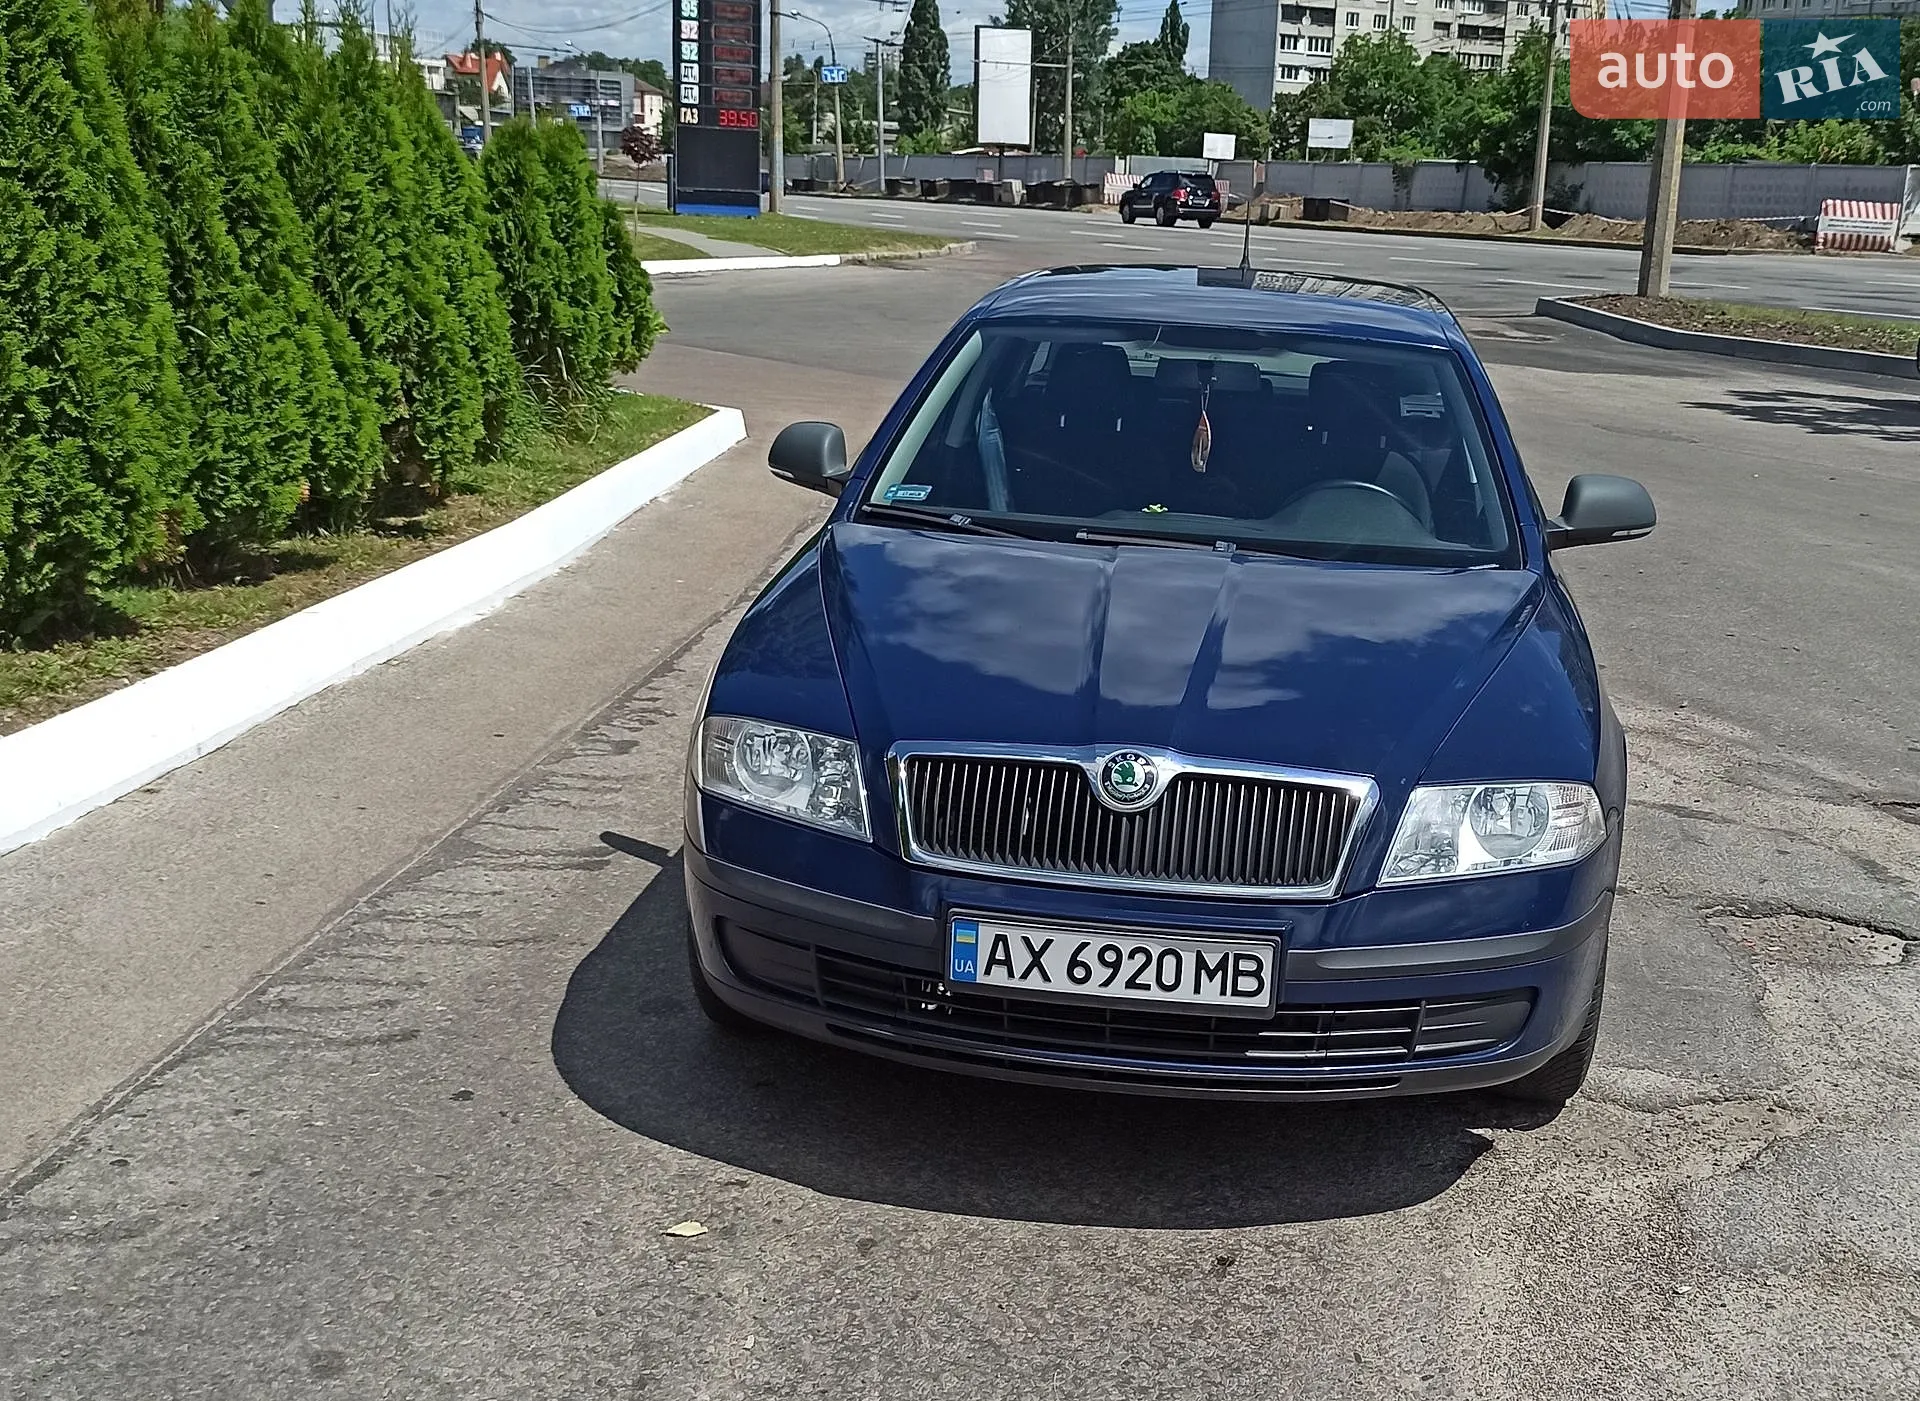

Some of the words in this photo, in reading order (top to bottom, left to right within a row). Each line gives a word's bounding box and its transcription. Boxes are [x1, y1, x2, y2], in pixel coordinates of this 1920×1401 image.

[680, 0, 699, 18] 95
[680, 21, 699, 39] 92
[680, 42, 699, 60] 92
[680, 107, 699, 124] ГАЗ
[719, 109, 758, 127] 39.50
[954, 958, 975, 974] UA
[983, 932, 1055, 983] AX
[1066, 941, 1183, 993] 6920
[1193, 949, 1266, 998] MB
